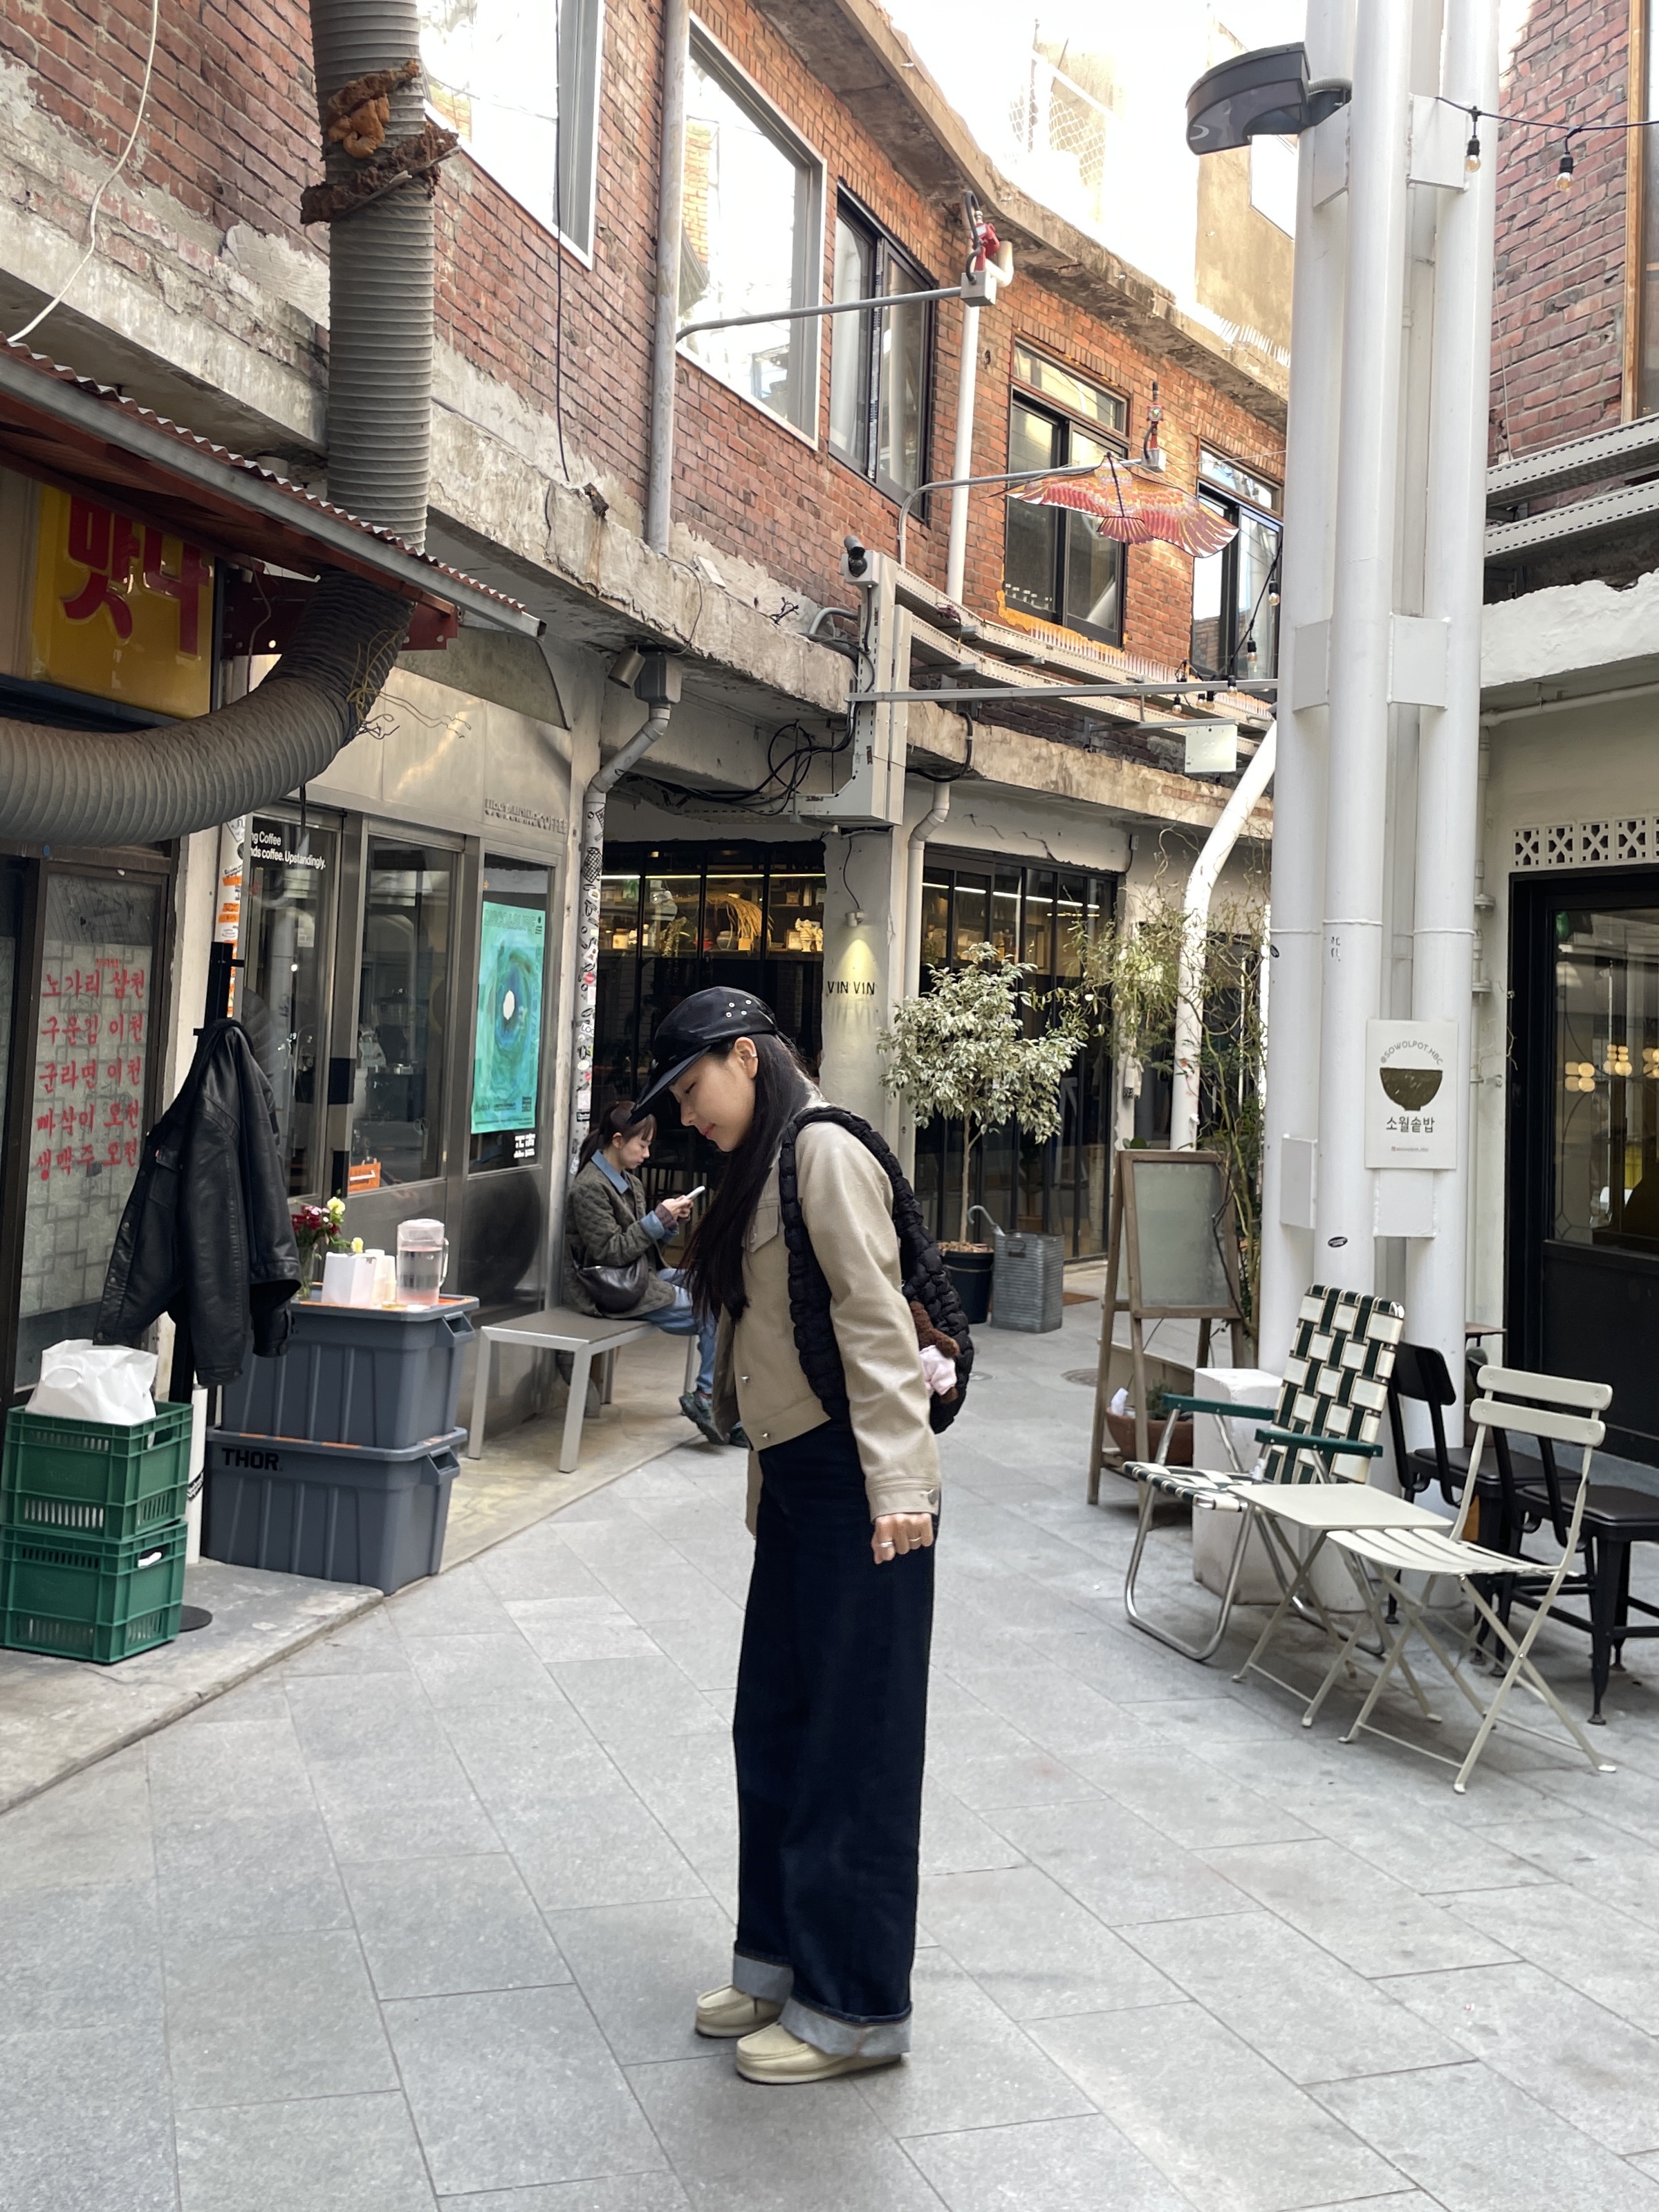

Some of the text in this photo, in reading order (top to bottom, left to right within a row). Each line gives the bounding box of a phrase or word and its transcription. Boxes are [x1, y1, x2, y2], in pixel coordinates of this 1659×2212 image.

[259, 830, 281, 846] Coffee
[262, 848, 284, 862] coffee.
[284, 851, 326, 870] Upstandingly.
[42, 968, 145, 1000] 노가리 삼천
[827, 980, 875, 994] VIN VIN
[41, 1012, 142, 1046] 구운김 이천
[39, 1056, 140, 1094] 군라면 이천
[104, 1098, 138, 1129] 오천
[1386, 1116, 1435, 1133] 소월솥밥
[36, 1137, 137, 1180] 생맥주 오천
[221, 1448, 279, 1471] THOR
